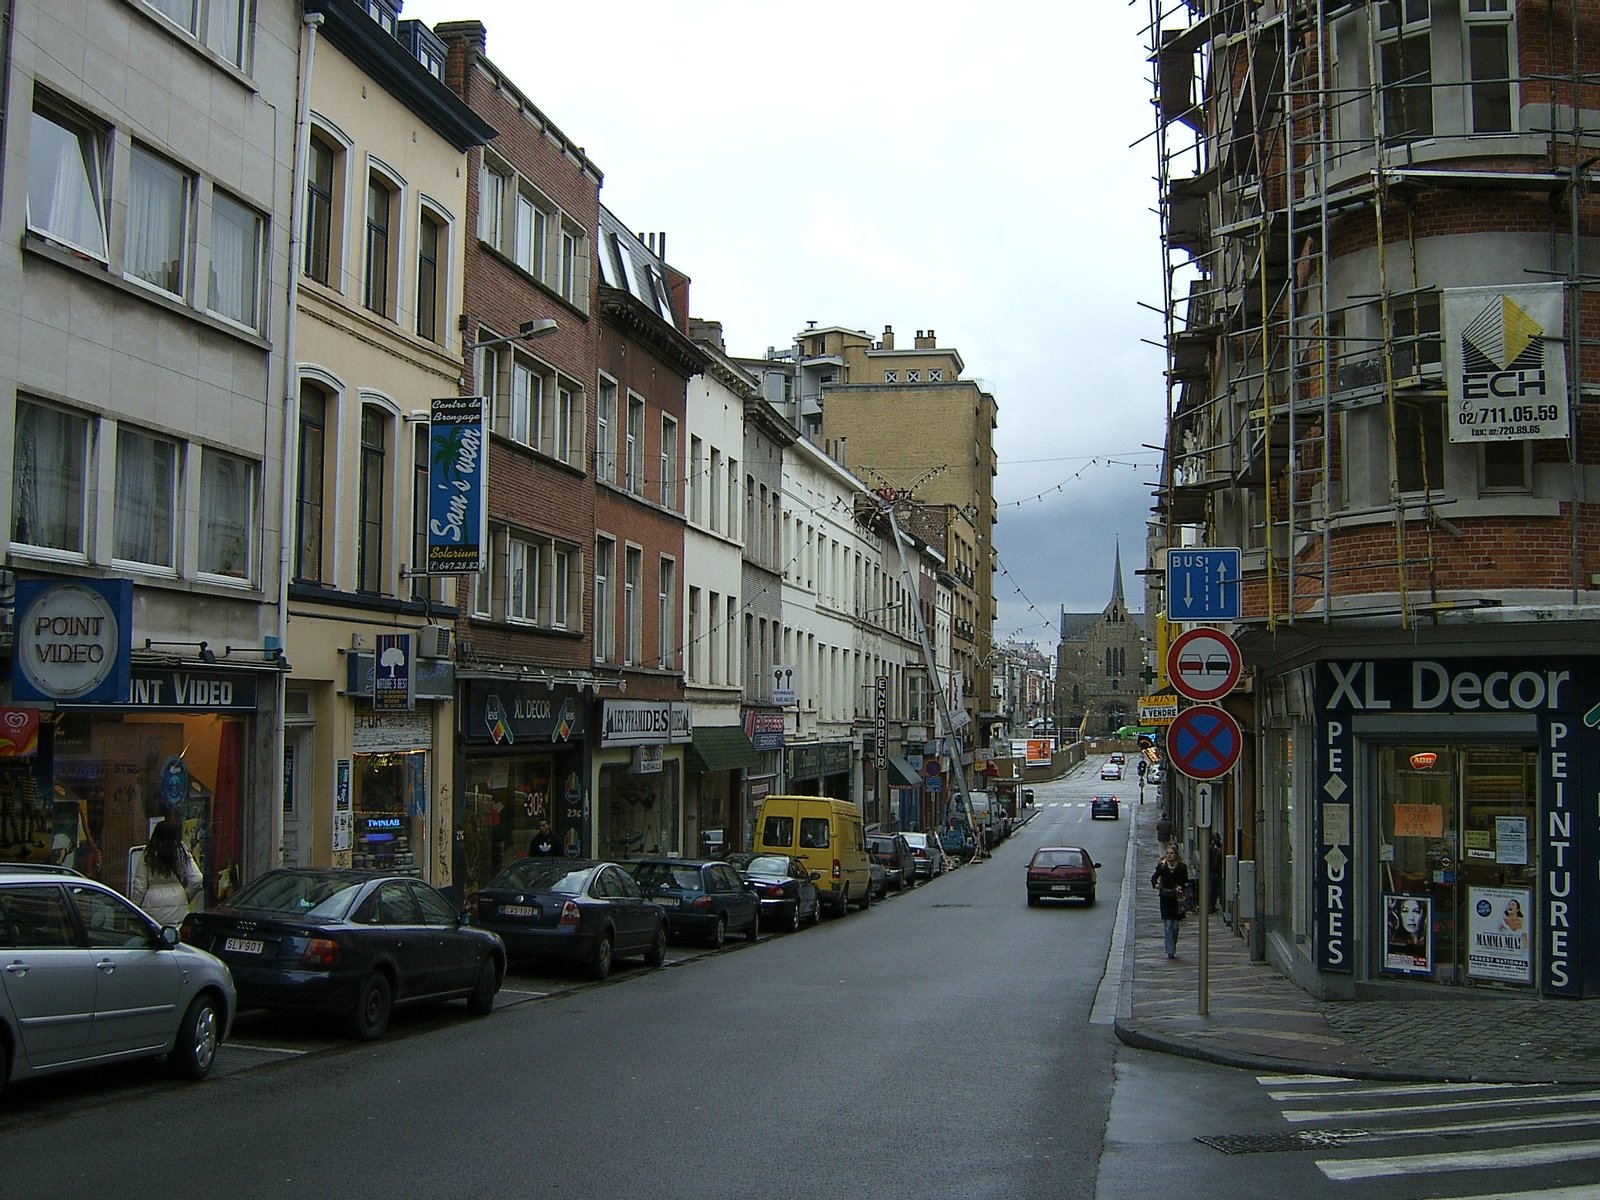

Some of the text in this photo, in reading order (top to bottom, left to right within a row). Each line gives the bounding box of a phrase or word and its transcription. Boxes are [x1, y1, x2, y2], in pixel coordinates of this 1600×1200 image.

[1462, 370, 1546, 399] ECH
[432, 399, 481, 409] Centre de
[433, 412, 480, 424] Bronzage
[1459, 405, 1558, 425] 02/711.05.59
[1472, 429, 1487, 437] fax:
[430, 428, 481, 542] Sam's wear
[430, 546, 478, 558] Solarium
[439, 561, 479, 570] 647.28.82
[1172, 556, 1204, 568] BUS
[35, 617, 104, 636] POINT
[35, 644, 104, 663] VIDEO
[129, 679, 163, 704] INT
[1326, 661, 1570, 710] XL Decor
[514, 699, 551, 719] XL DECOR
[1148, 709, 1176, 717] VENDRE
[614, 710, 624, 733] LES
[624, 709, 669, 733] PYRAMIDES
[755, 715, 783, 733] EXPRESS
[877, 678, 887, 767] ENCADREUR
[1327, 721, 1345, 965] PEURES
[1550, 722, 1571, 988] PEINTURES
[1476, 933, 1521, 949] MAMMA MIA!
[1471, 955, 1493, 963] FOREST
[1495, 958, 1527, 967] NATIONAL
